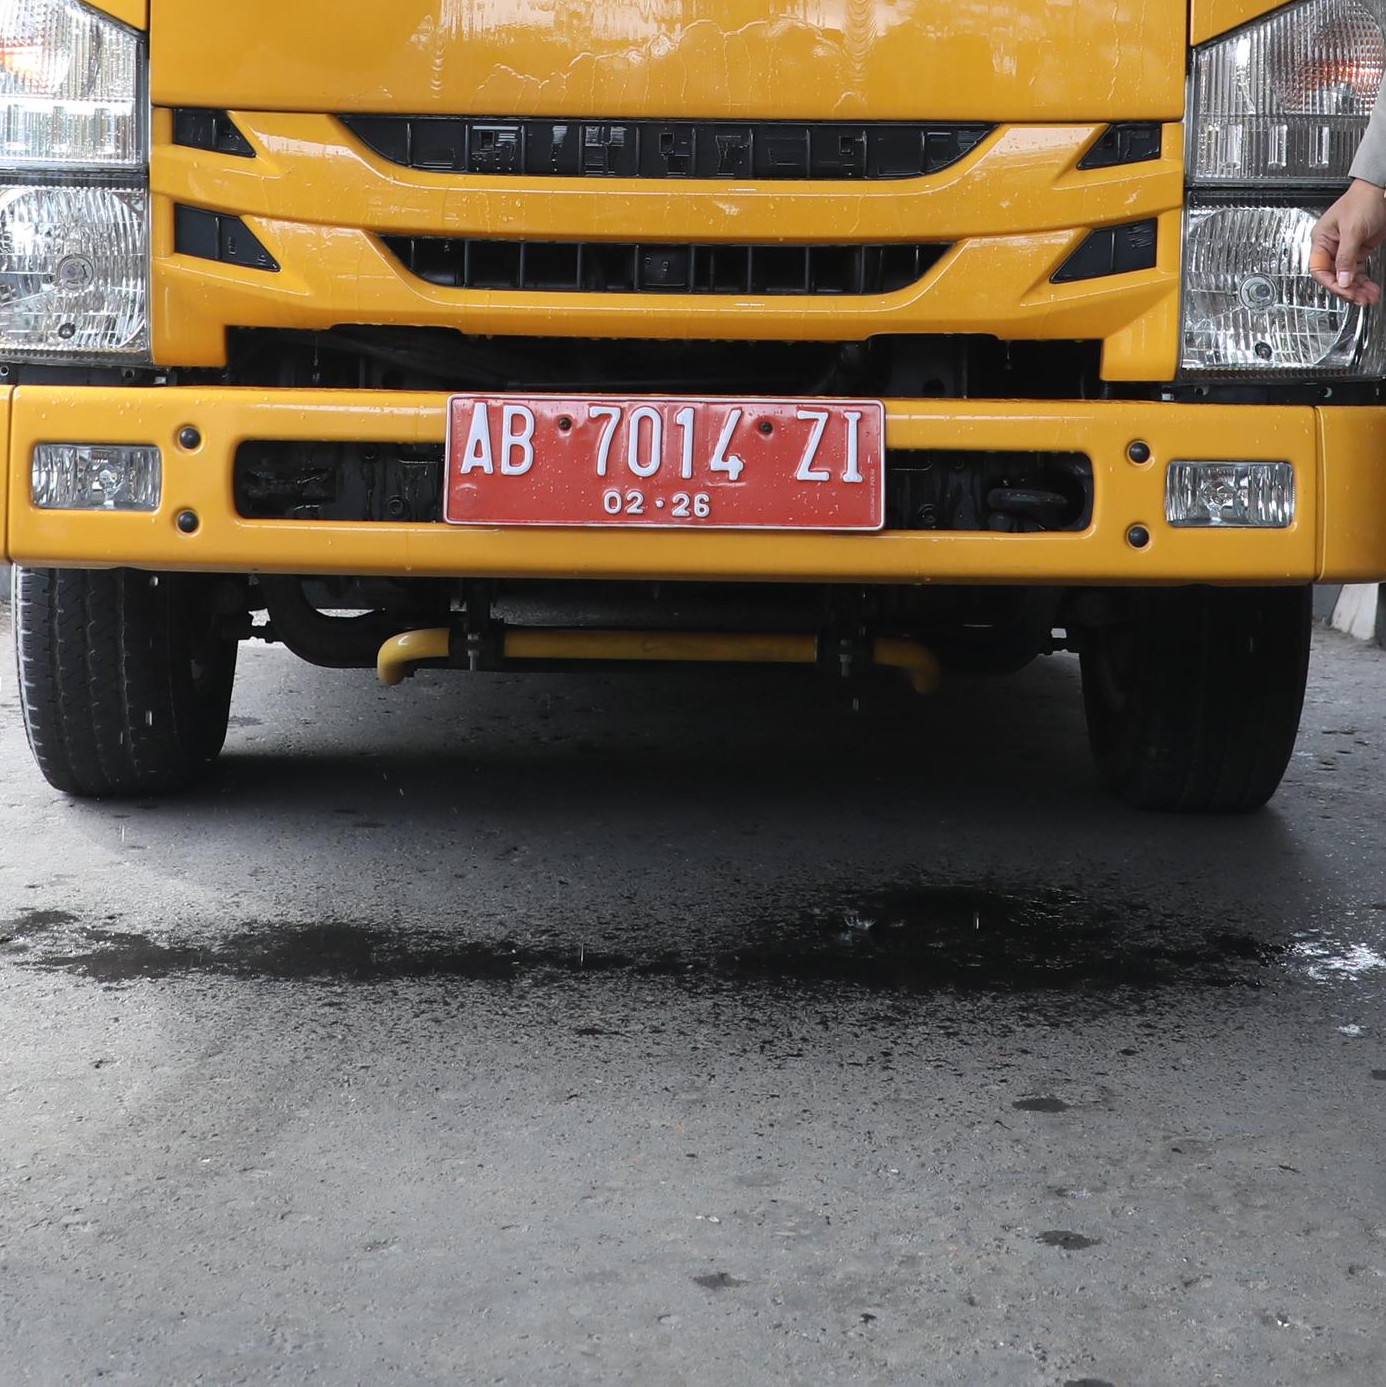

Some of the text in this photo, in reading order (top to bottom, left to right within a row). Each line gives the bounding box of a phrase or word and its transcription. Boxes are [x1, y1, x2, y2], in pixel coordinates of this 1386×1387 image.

[459, 402, 864, 483] AB 7014 ZI
